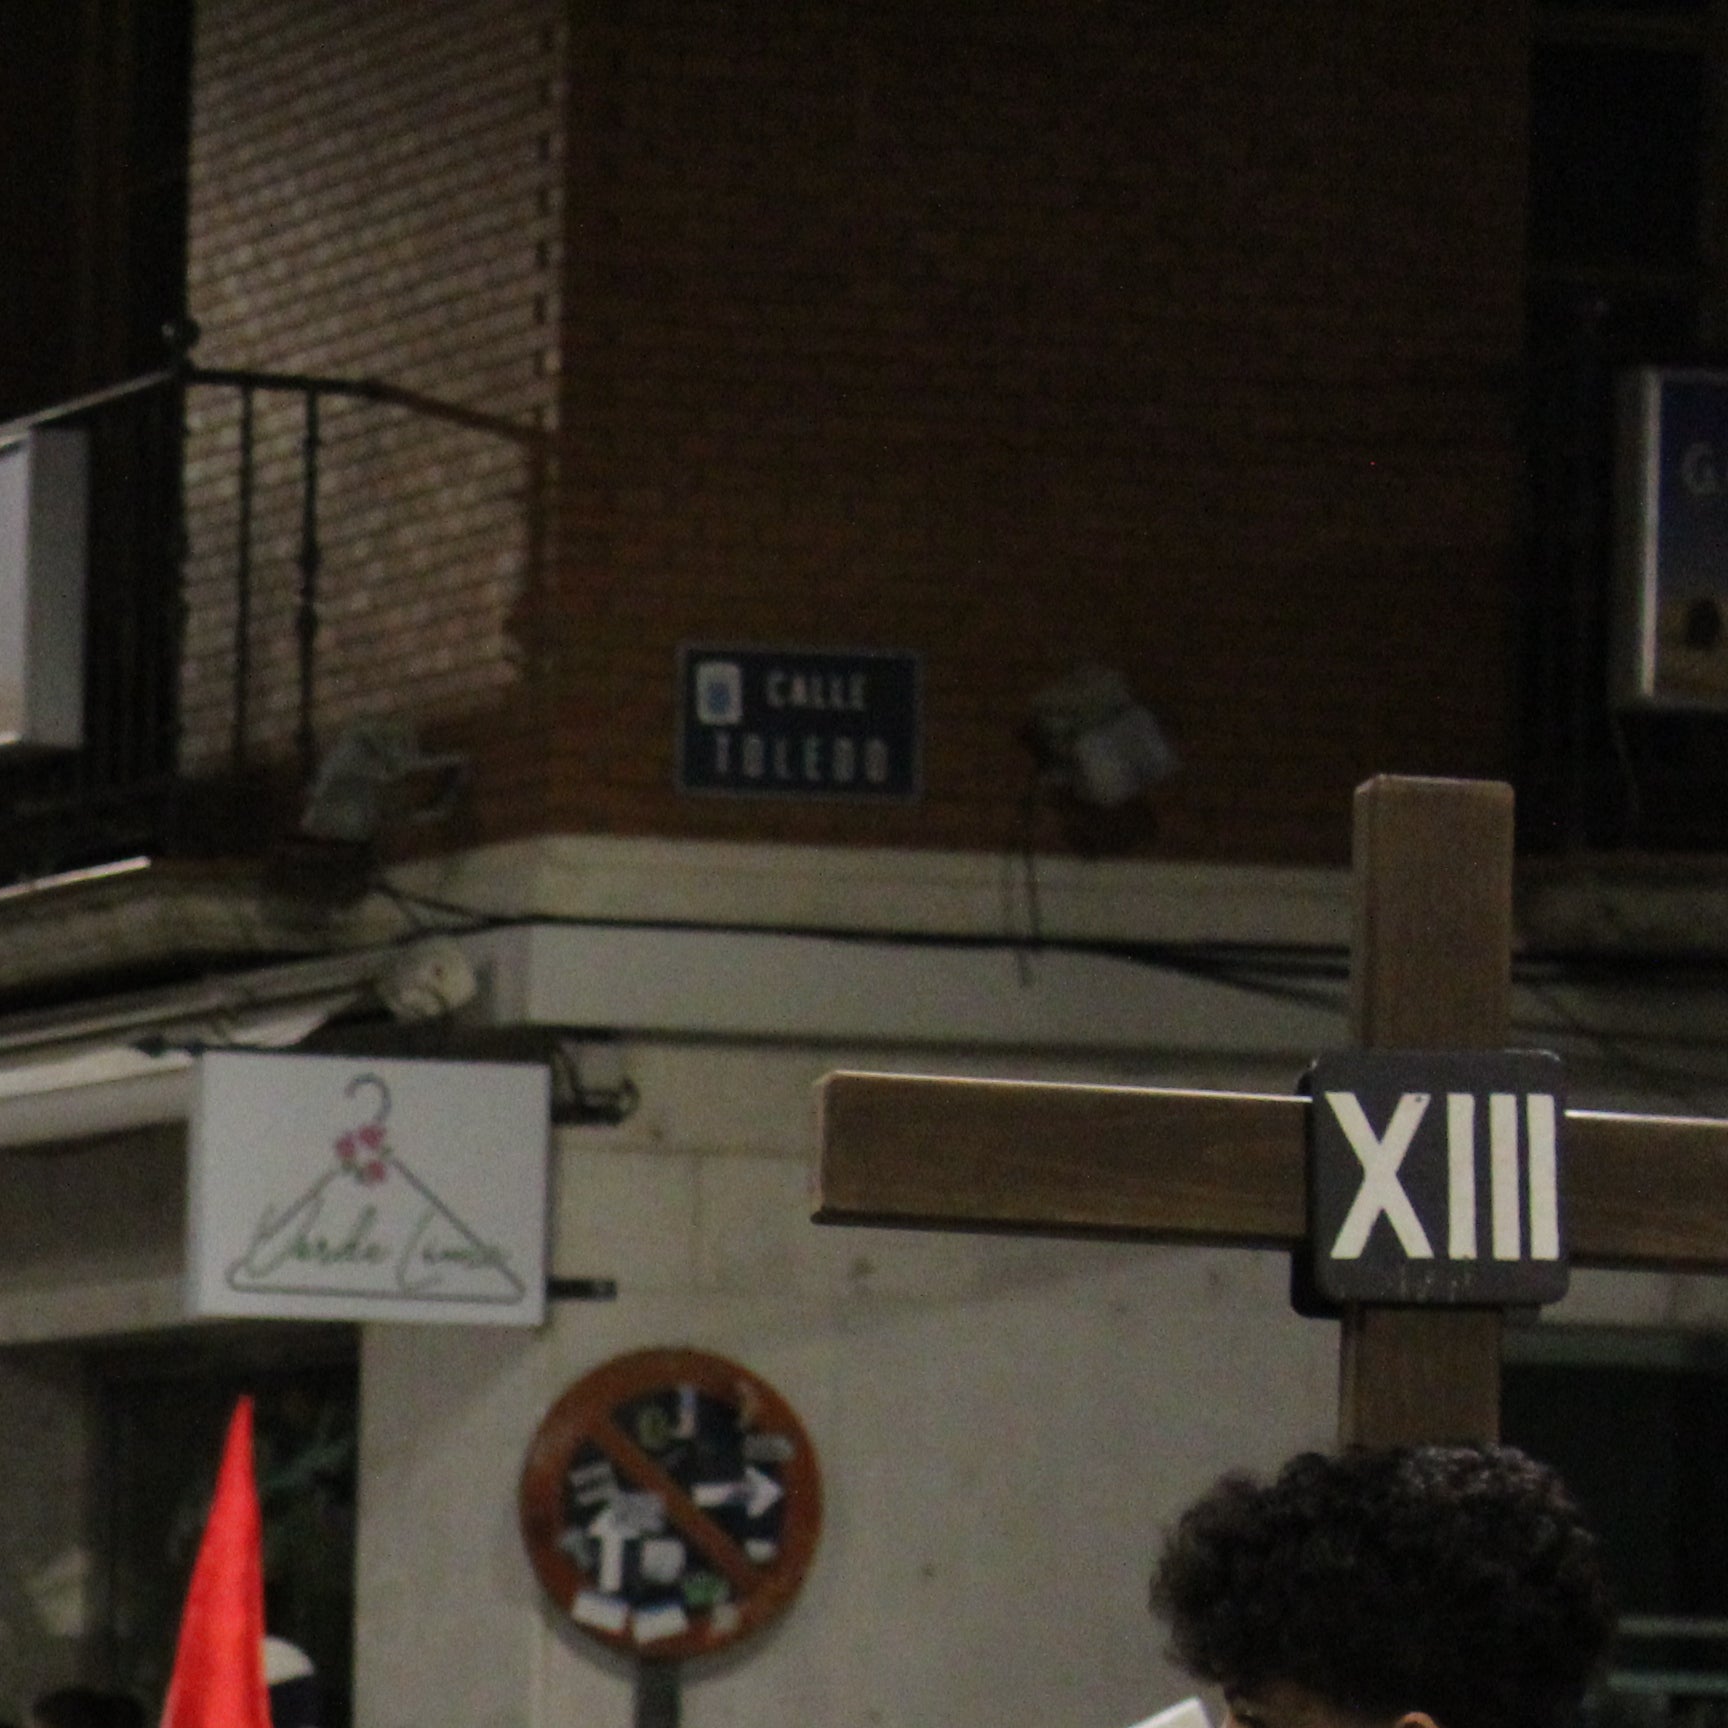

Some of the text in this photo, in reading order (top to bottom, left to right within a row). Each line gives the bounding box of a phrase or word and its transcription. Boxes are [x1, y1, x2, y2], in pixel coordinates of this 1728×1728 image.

[766, 667, 866, 712] CALLE
[715, 731, 889, 784] TOLEDO
[1324, 1091, 1560, 1260] XIII
